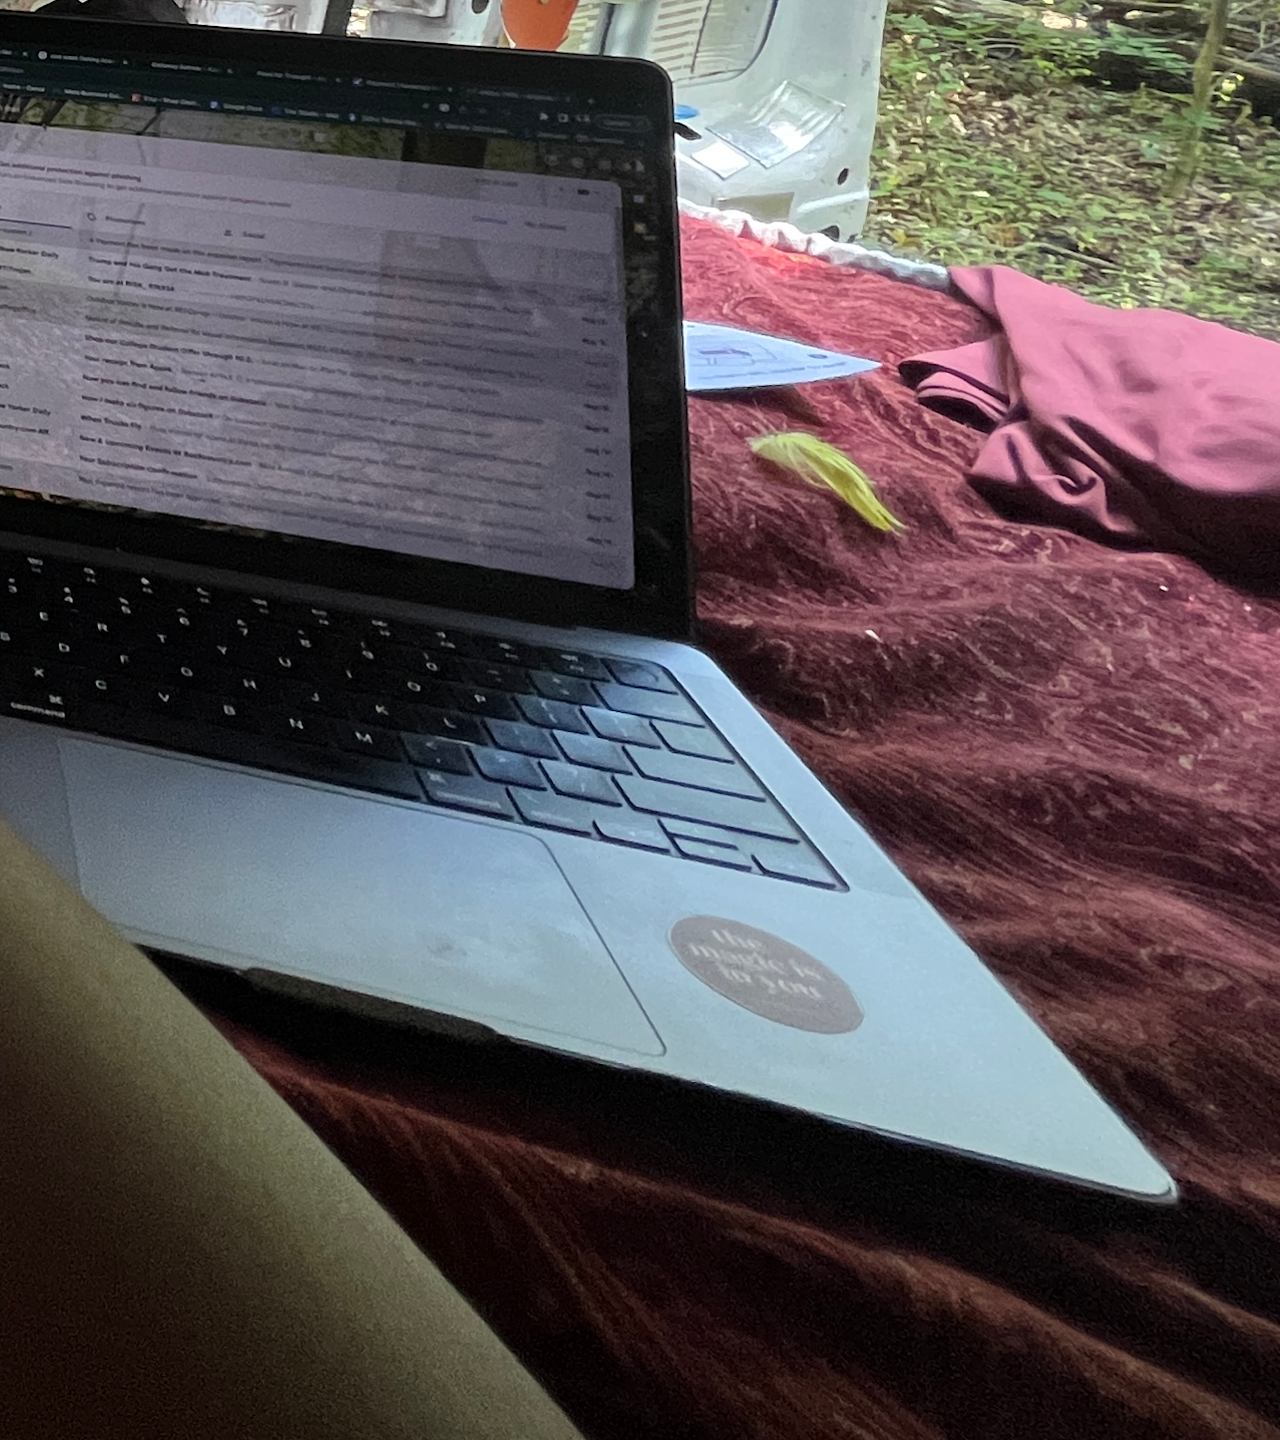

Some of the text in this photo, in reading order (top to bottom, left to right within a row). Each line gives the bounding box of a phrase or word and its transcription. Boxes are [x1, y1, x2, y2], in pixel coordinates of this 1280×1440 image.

[41, 250, 59, 259] Daily
[32, 407, 51, 416] Daily
[157, 633, 167, 643] T
[58, 643, 70, 652] D
[217, 645, 227, 655] Y
[278, 656, 291, 668] U
[34, 667, 44, 678] X
[95, 680, 107, 690] C
[407, 681, 421, 692] O
[158, 692, 170, 702] V
[10, 702, 65, 718] command
[355, 731, 373, 744] M
